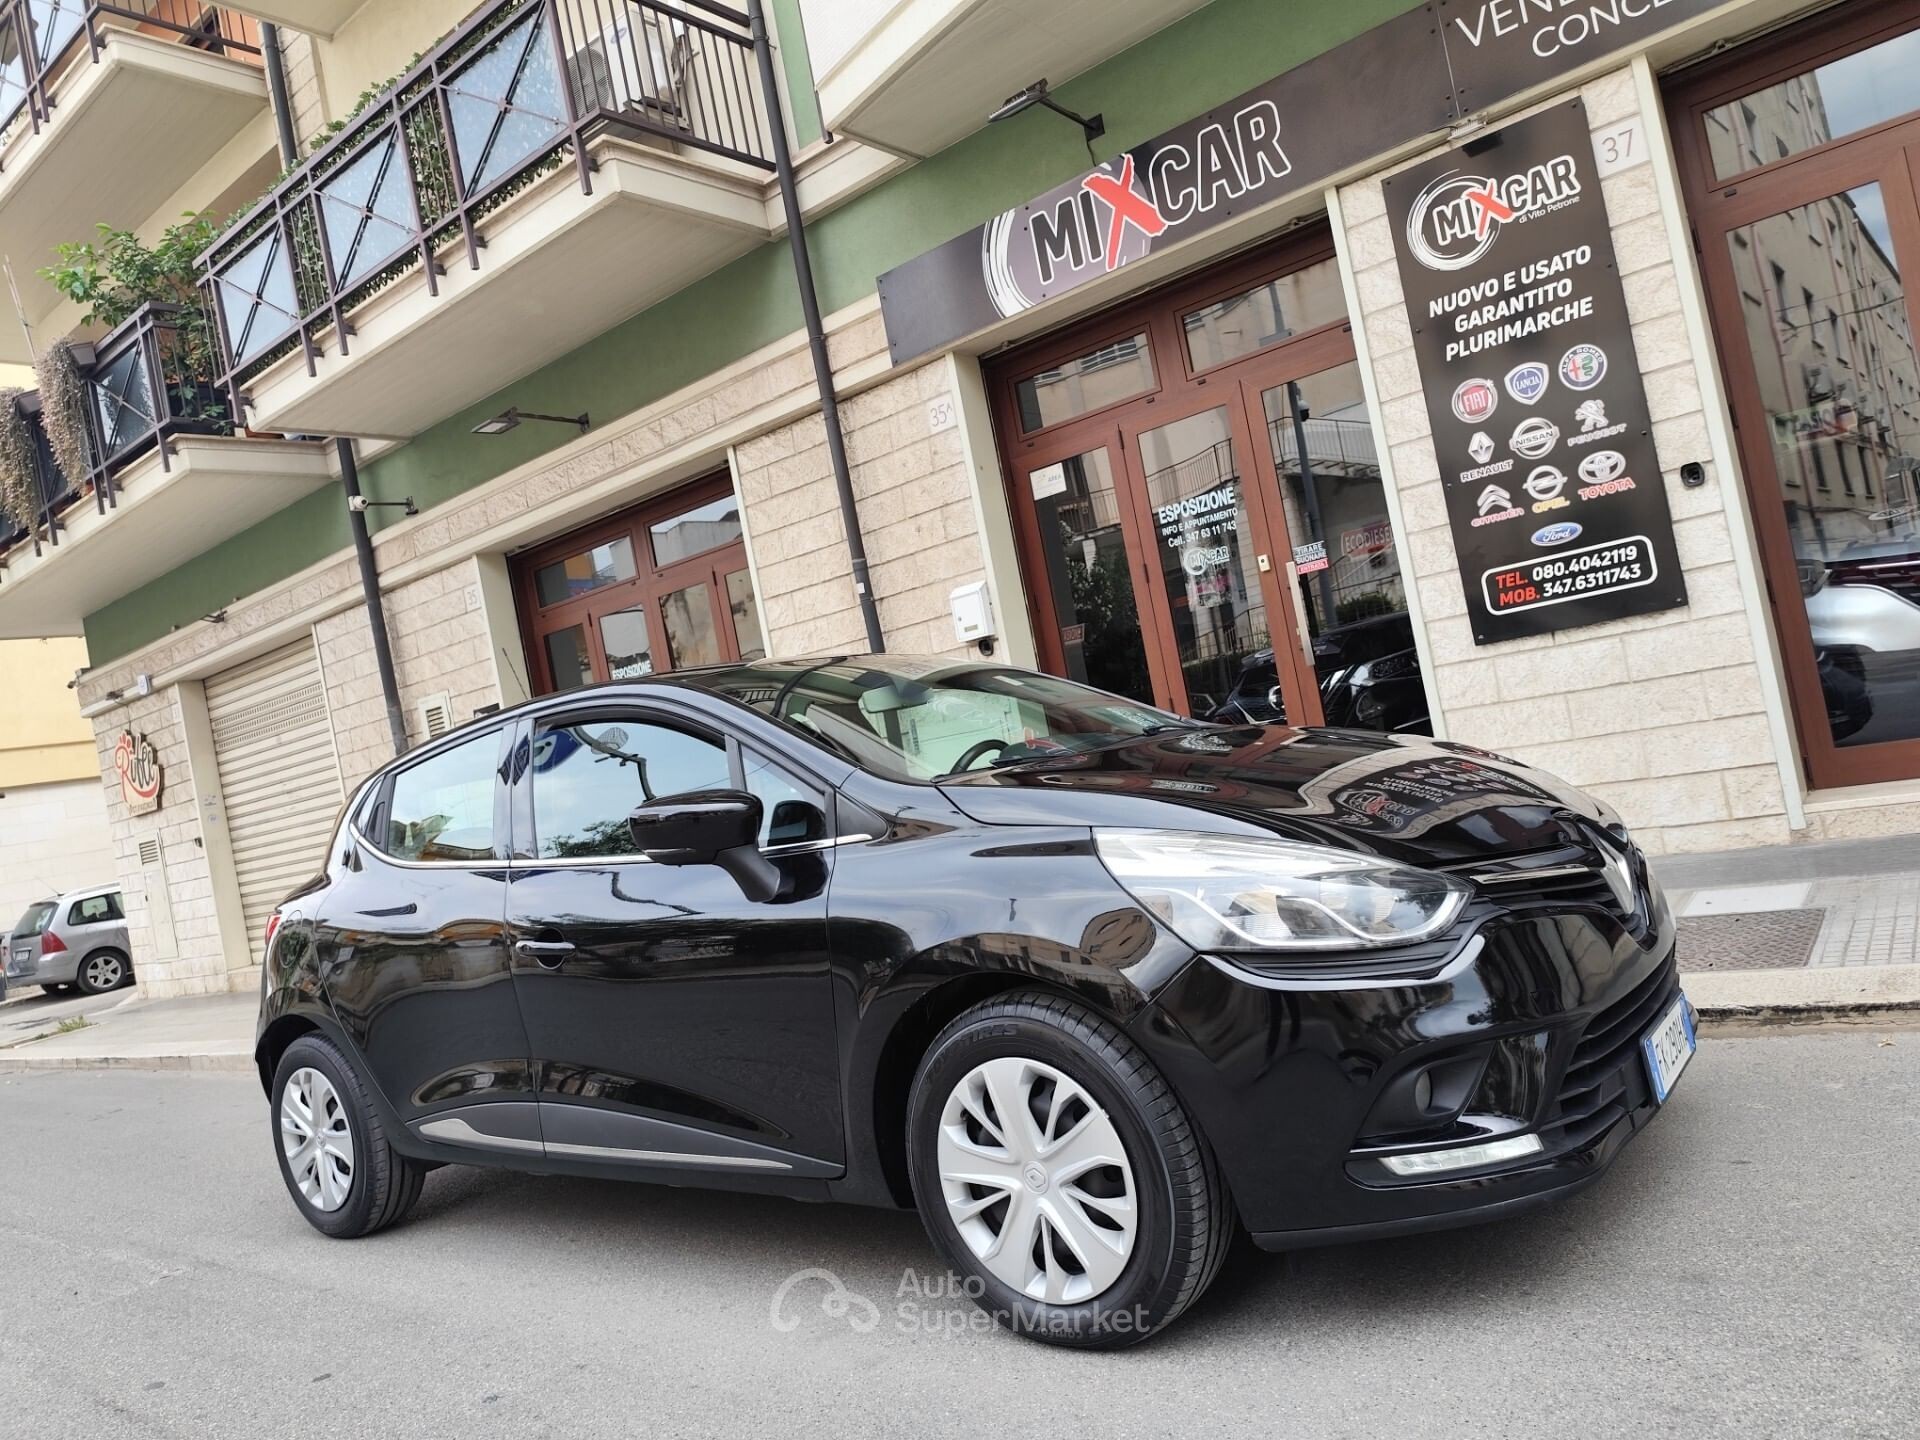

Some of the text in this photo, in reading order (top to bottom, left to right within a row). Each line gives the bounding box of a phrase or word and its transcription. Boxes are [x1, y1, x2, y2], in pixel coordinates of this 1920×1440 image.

[1455, 0, 1576, 47] VEN
[1532, 0, 1673, 57] CONC
[1601, 127, 1634, 163] 37
[1028, 100, 1292, 286] MIXCAR
[1432, 155, 1582, 246] MIXCAR
[1519, 195, 1581, 224] di Vito Petrone
[1429, 245, 1592, 318] NUOVO E USATO
[1454, 278, 1573, 333] GARANTITO
[1446, 296, 1594, 362] PLURIMARCHE
[1463, 388, 1488, 413] FIAT
[1516, 375, 1541, 391] LANCIA
[1515, 430, 1554, 447] NISSAN
[1460, 459, 1514, 482] RENAULT
[1578, 476, 1636, 501] TOYOTA
[1158, 486, 1236, 524] ESPOSIZIONE
[1162, 507, 1239, 536] INFO E APPUNTAMENTO
[1185, 530, 1199, 543] 347
[1201, 527, 1211, 538] 63
[1212, 524, 1221, 535] 11
[1222, 520, 1237, 533] 743
[1542, 526, 1571, 542] Ford
[1496, 545, 1638, 589] TEL. 080.4042119
[1500, 563, 1642, 606] MOB. 347.6311743
[612, 660, 652, 680] ESPOSIZIONE
